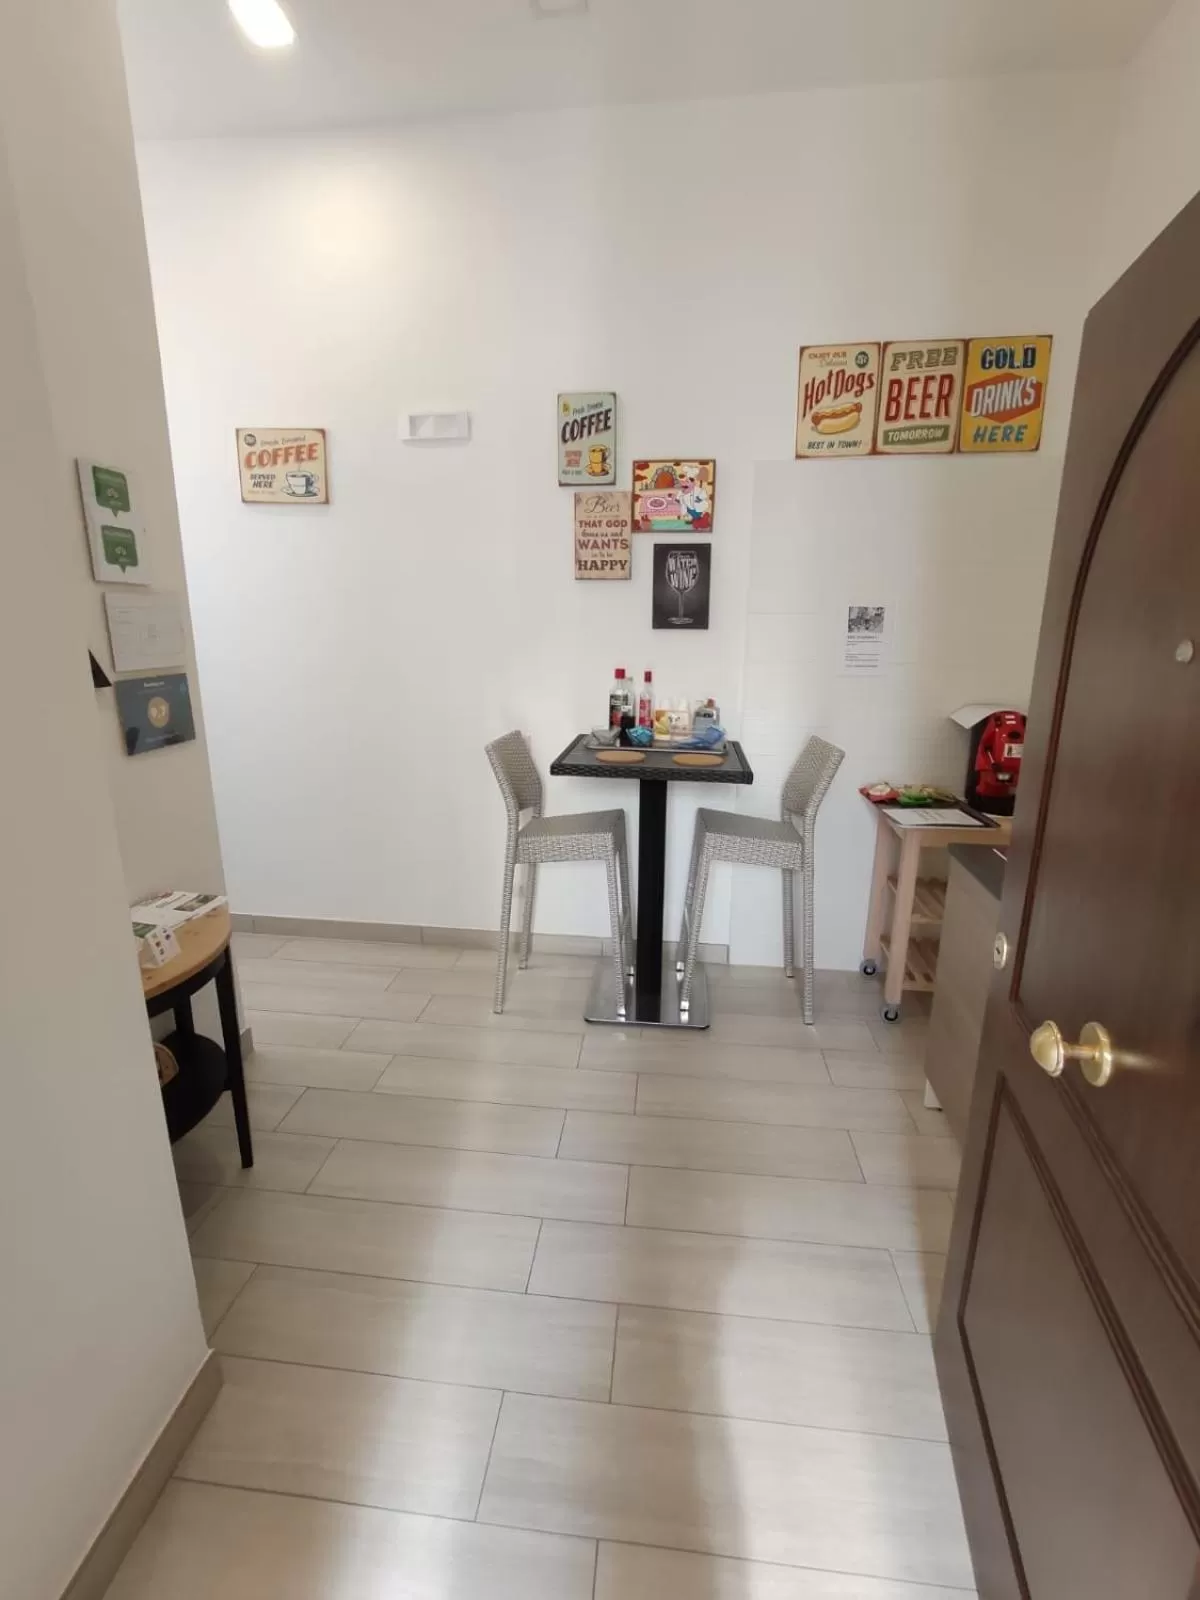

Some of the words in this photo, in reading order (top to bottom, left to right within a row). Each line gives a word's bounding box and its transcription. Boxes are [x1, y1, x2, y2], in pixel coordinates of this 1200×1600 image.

[890, 347, 958, 372] FREE
[980, 345, 1037, 370] COLD
[884, 373, 955, 422] BEER
[970, 376, 1037, 418] DRINKS
[561, 408, 612, 444] COFFEE
[887, 427, 945, 443] TOMORROW
[973, 425, 1028, 443] HERE
[807, 441, 824, 450] BEST
[244, 442, 319, 469] COFFEE
[584, 496, 621, 513] Beer
[578, 520, 602, 529] THAT
[605, 519, 628, 528] GOD
[578, 539, 629, 550] WANTS
[577, 559, 628, 571] HAPPY
